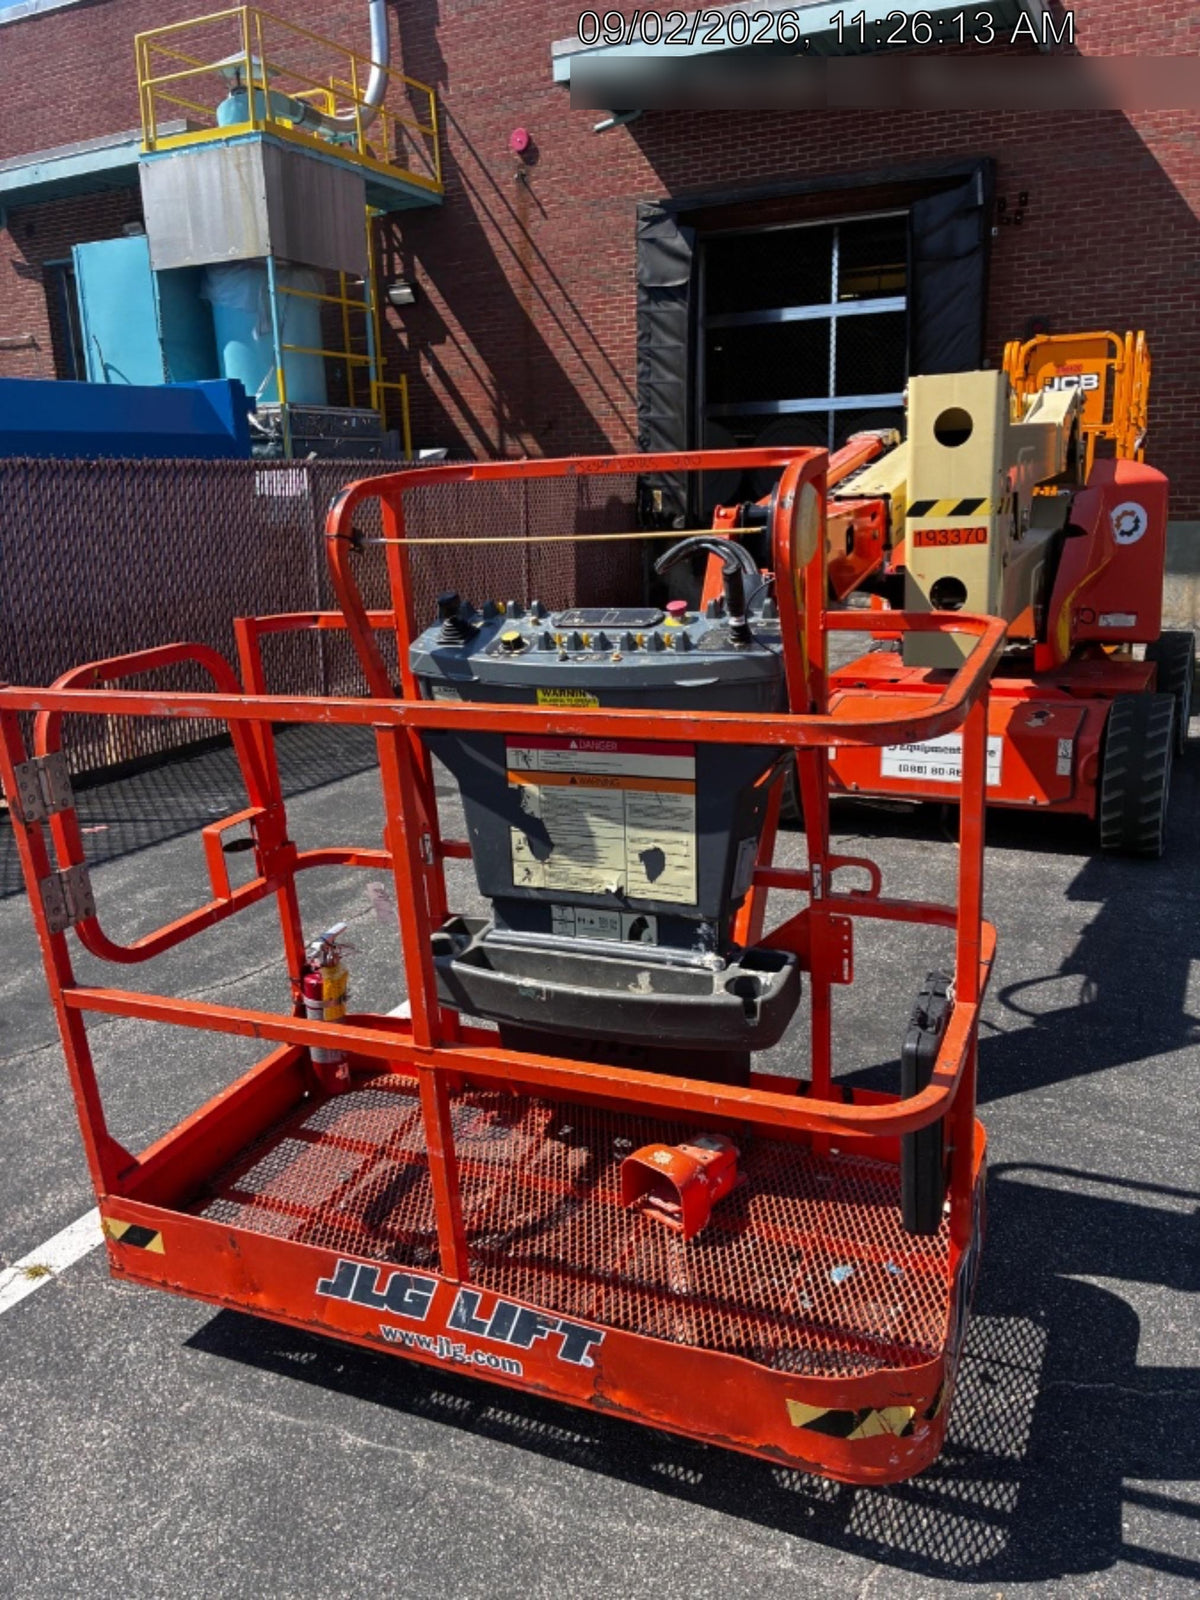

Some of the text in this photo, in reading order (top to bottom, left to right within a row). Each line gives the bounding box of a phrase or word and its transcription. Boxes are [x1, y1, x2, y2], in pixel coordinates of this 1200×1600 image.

[1044, 374, 1099, 392] JCB
[914, 527, 988, 547] 193370
[543, 688, 588, 698] WARNIN
[579, 739, 618, 751] DANGER
[577, 776, 620, 788] WARNING
[315, 1258, 606, 1366] JLG LIFT
[379, 1324, 523, 1376] www.jlg.com
